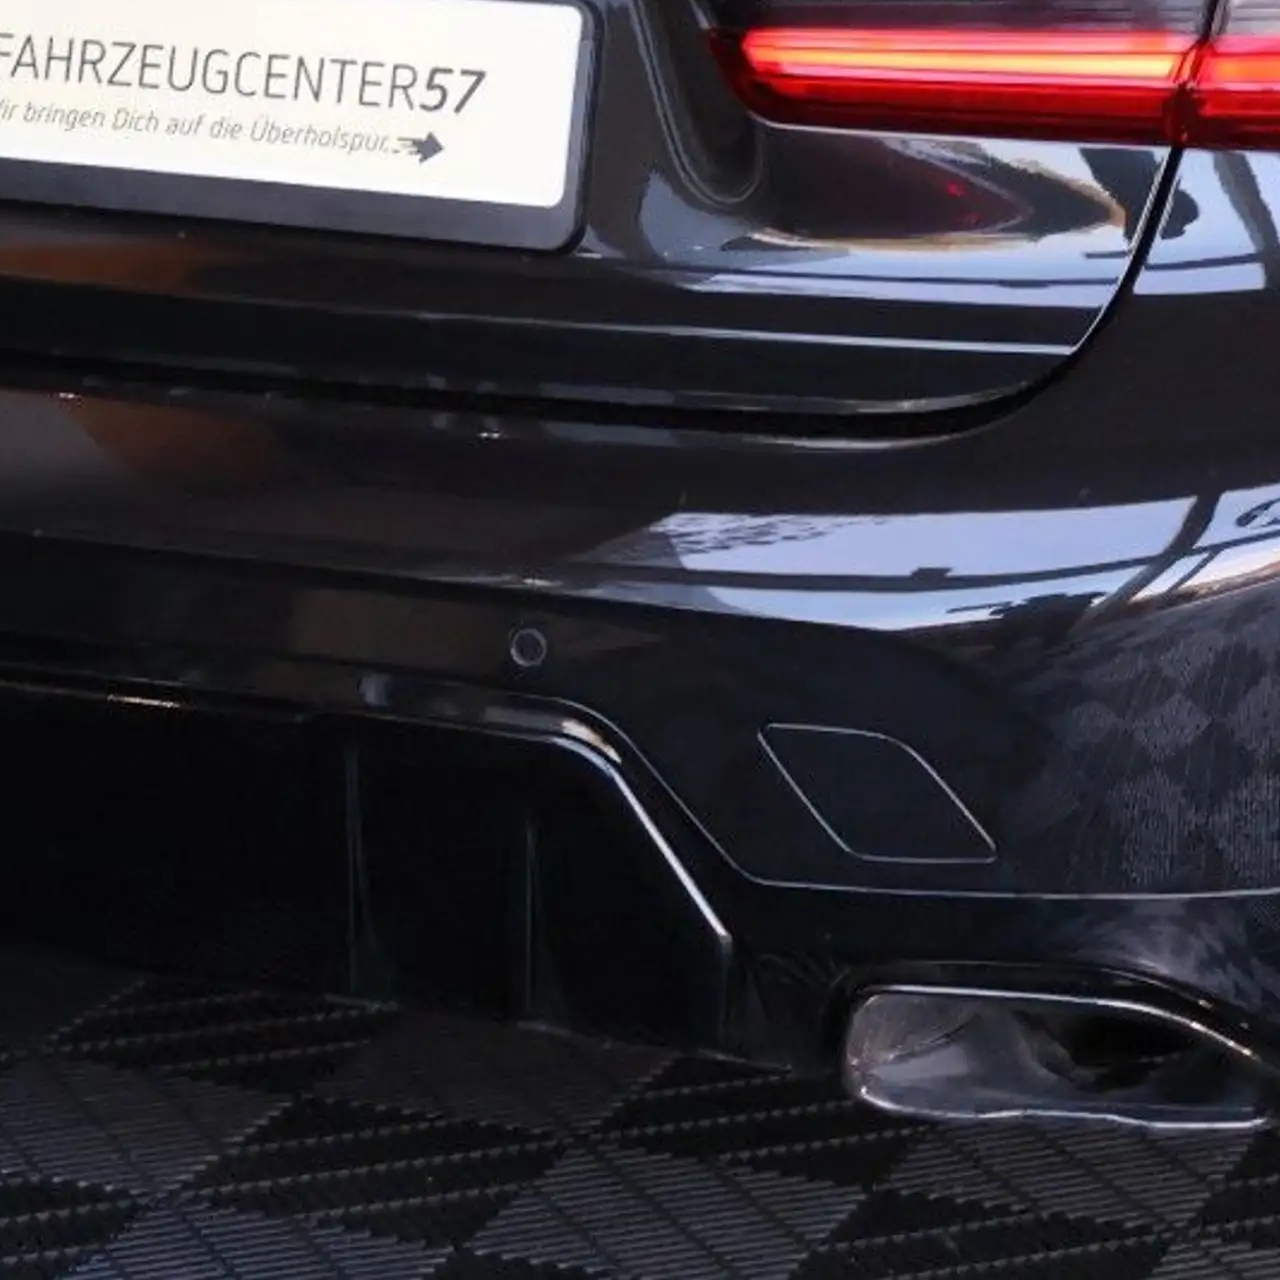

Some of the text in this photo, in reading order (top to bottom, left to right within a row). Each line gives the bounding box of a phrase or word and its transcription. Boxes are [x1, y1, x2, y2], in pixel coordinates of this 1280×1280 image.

[22, 101, 106, 132] bringen
[111, 107, 160, 133] Dich
[165, 114, 207, 136] auf
[208, 115, 244, 140] die
